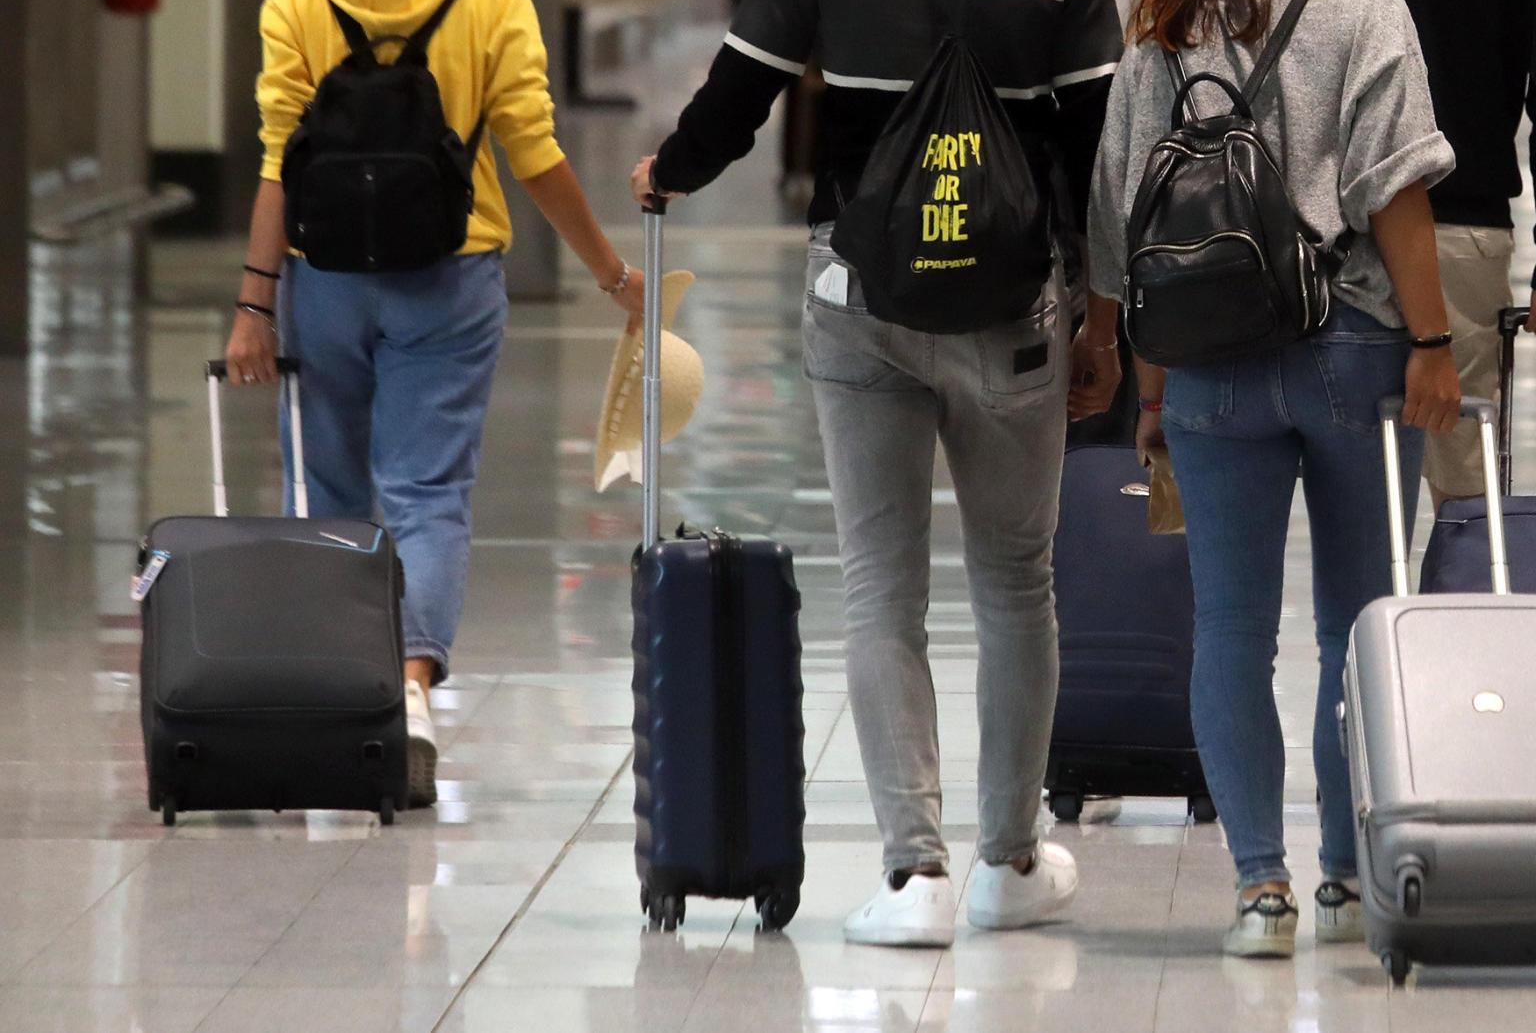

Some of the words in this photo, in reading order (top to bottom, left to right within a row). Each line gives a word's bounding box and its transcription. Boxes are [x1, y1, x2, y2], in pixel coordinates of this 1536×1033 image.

[932, 174, 960, 202] OR
[921, 203, 969, 243] DIE
[924, 257, 978, 271] PAPAYA
